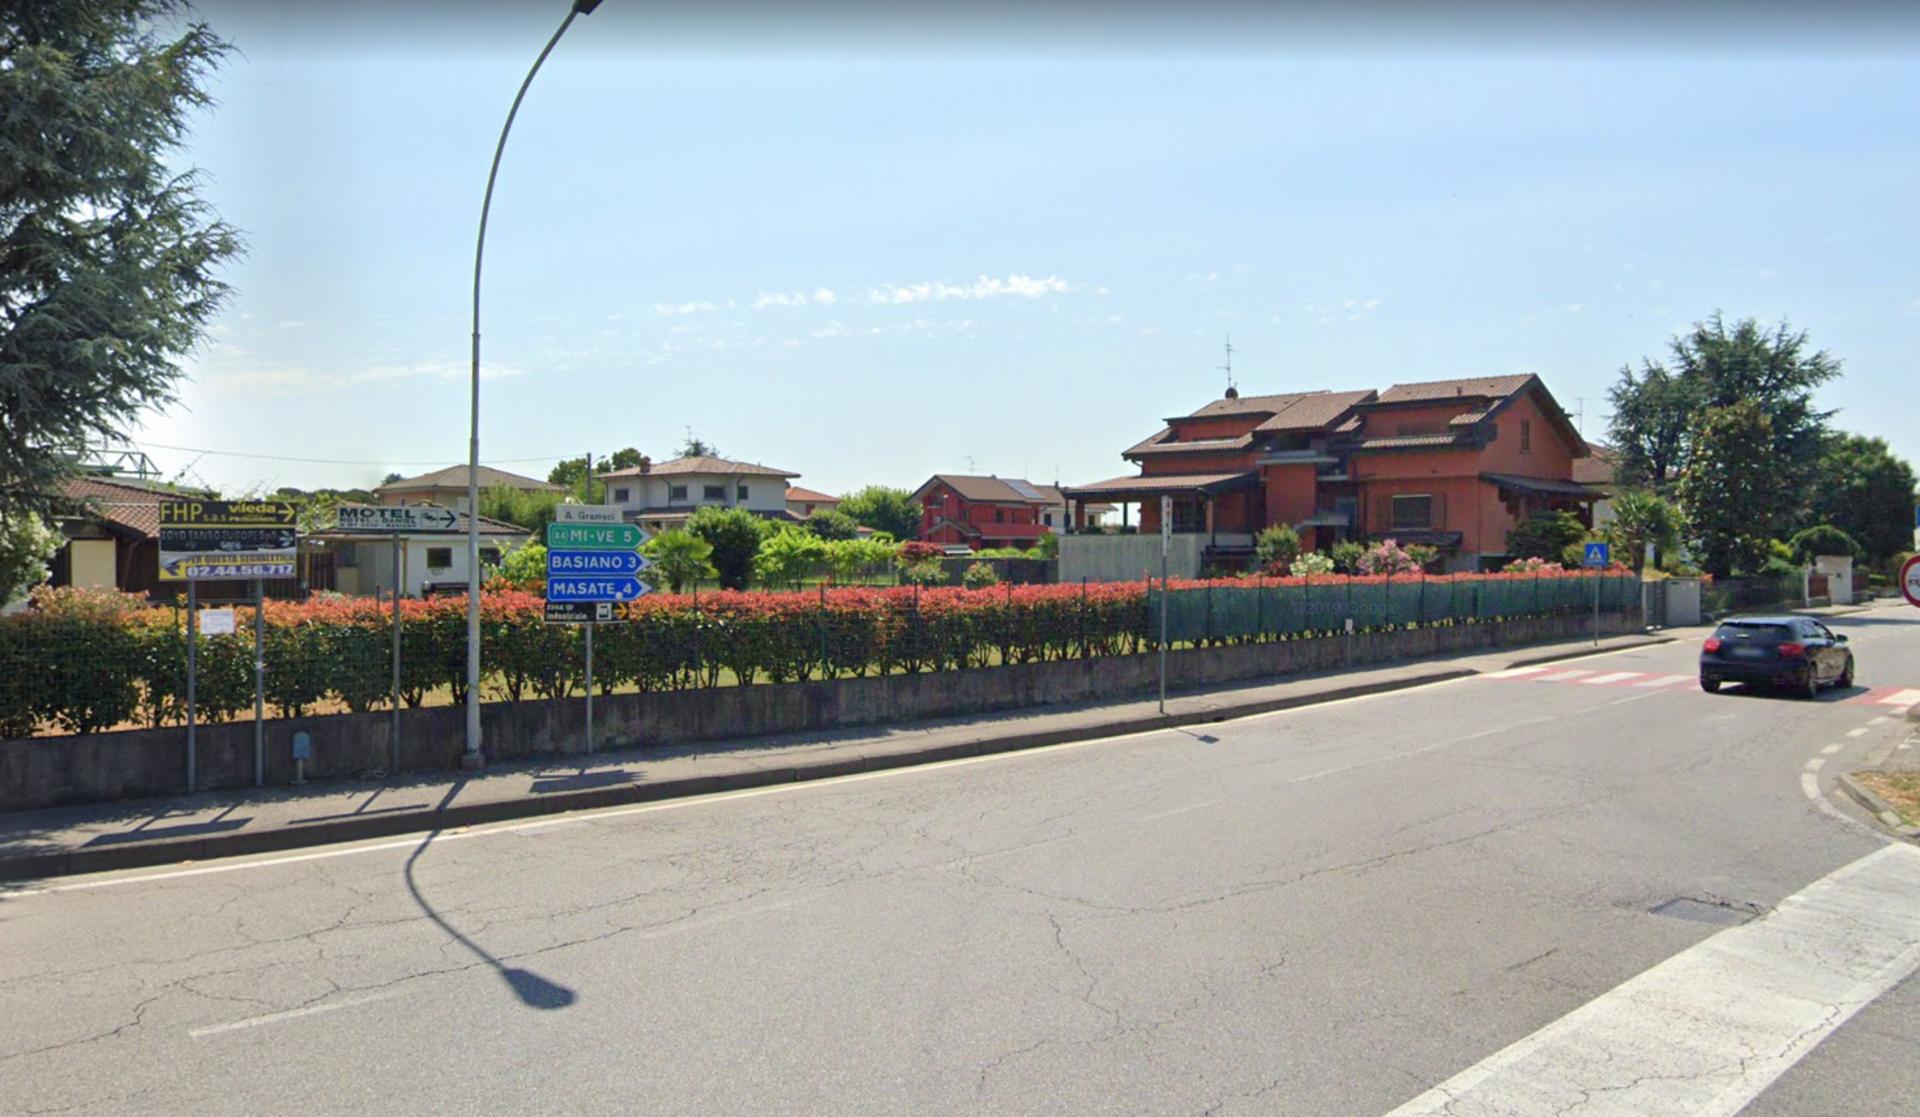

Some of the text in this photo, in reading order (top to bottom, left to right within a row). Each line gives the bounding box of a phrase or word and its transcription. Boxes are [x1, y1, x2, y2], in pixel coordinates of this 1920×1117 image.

[161, 502, 202, 521] FHP
[228, 502, 276, 513] vileda
[340, 508, 416, 519] MOTEL
[578, 511, 615, 521] Gramsci
[188, 530, 220, 540] TANSO
[570, 530, 615, 542] MI-VE
[623, 530, 632, 543] 5
[552, 556, 636, 568] BASIANO 3
[186, 564, 295, 577] 02.44.56.717
[553, 582, 633, 595] MASATE 4
